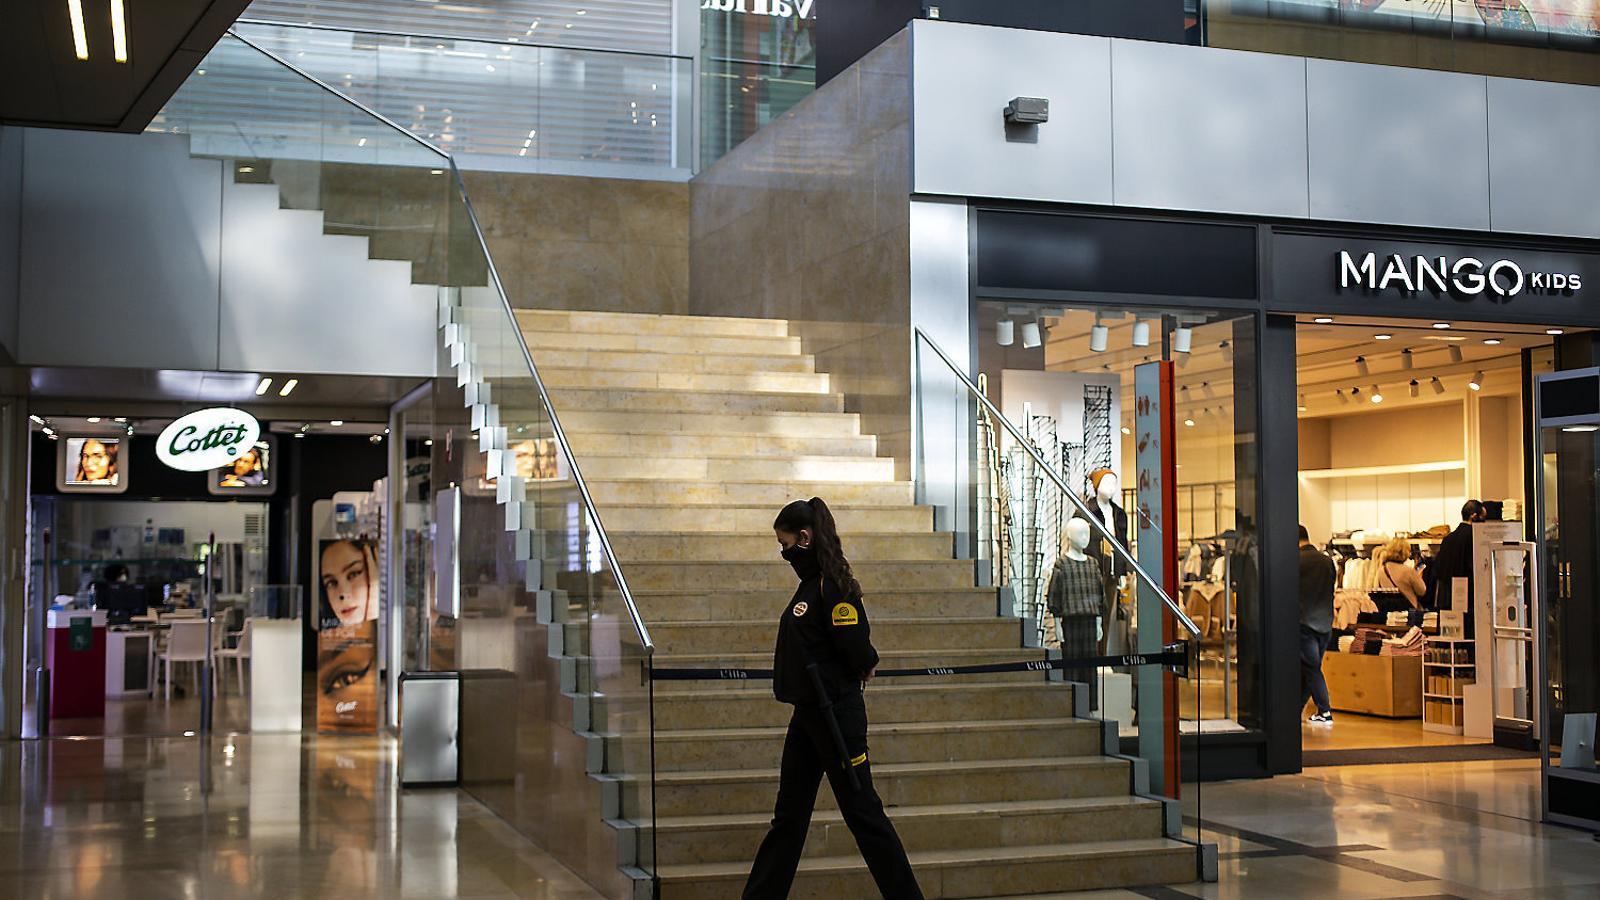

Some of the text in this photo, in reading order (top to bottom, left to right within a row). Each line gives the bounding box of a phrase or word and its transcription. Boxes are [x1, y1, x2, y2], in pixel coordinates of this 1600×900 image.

[1340, 250, 1582, 296] MANGO KIDS
[169, 423, 248, 456] Cottet
[1026, 660, 1053, 670] L'illa
[1122, 655, 1147, 665] L'illa
